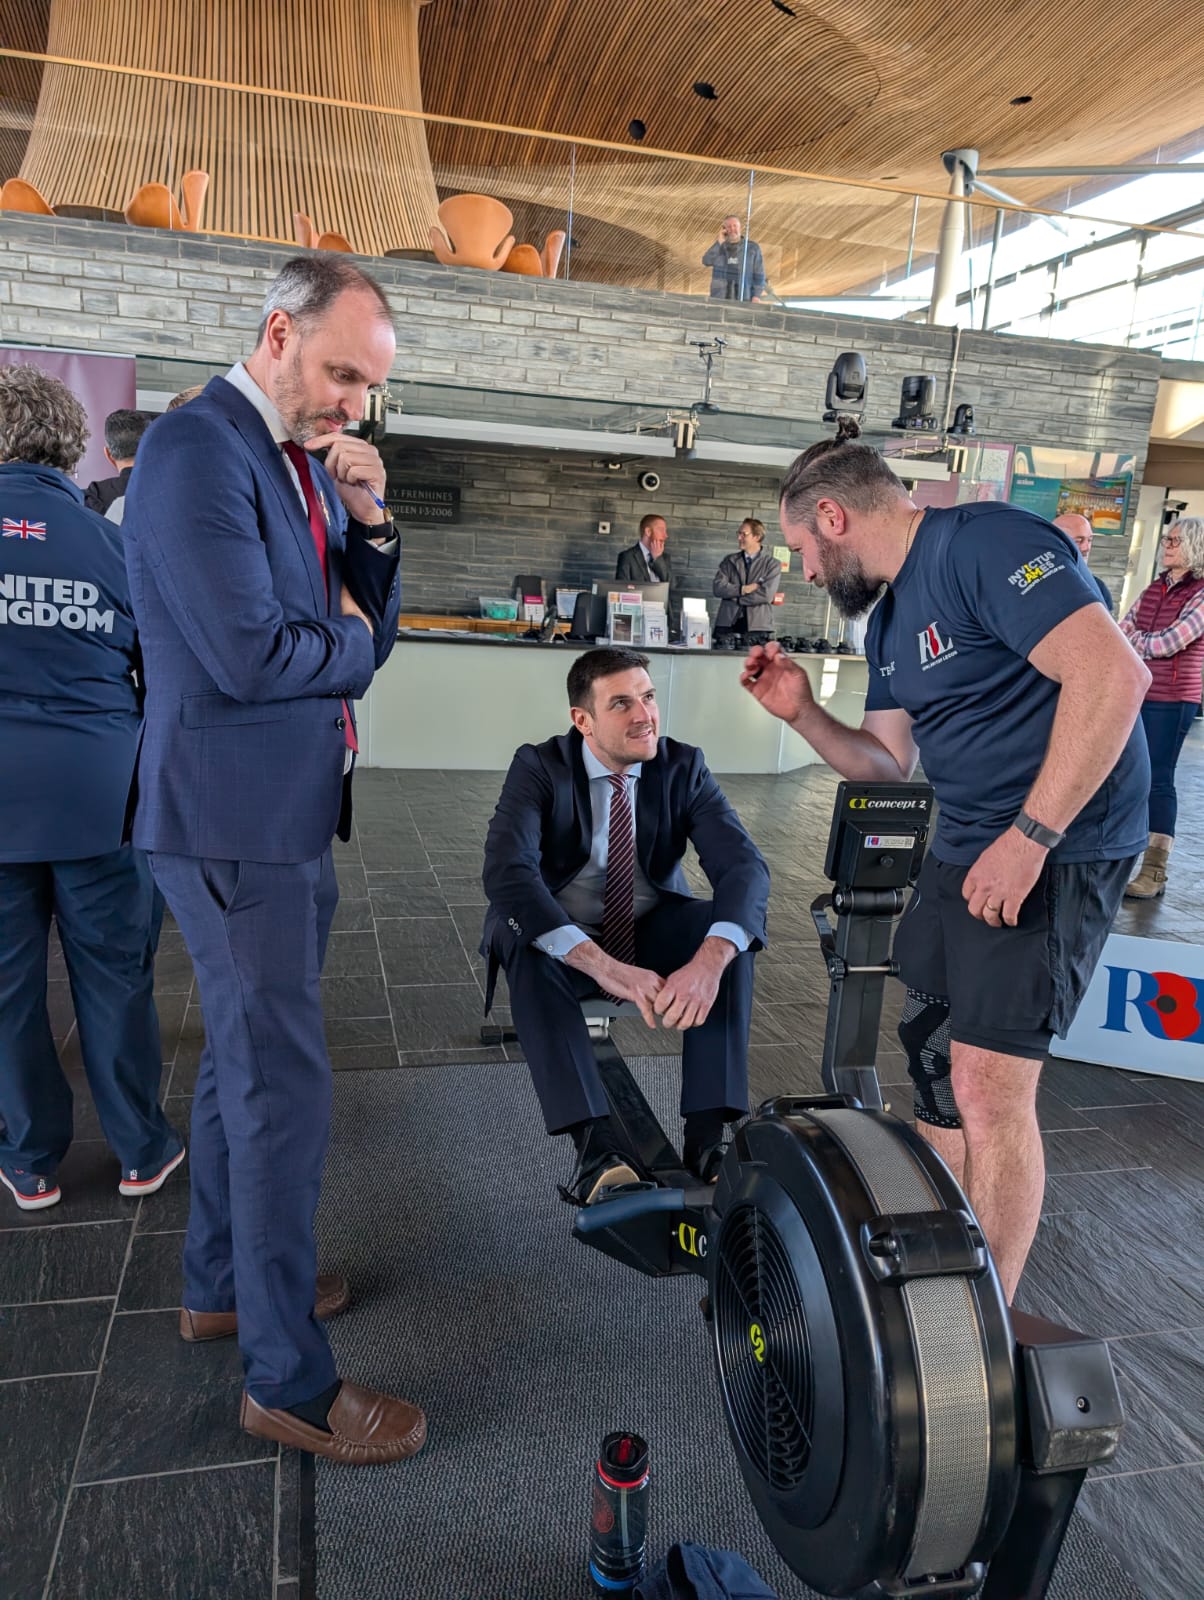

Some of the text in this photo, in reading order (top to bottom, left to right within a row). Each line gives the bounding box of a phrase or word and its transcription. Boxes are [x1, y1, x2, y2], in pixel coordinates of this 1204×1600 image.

[392, 489, 399, 497] Y
[401, 489, 453, 501] FRENHINES
[1008, 551, 1055, 585] INVICTUS
[1018, 560, 1055, 588] GAMES
[867, 800, 916, 810] concept
